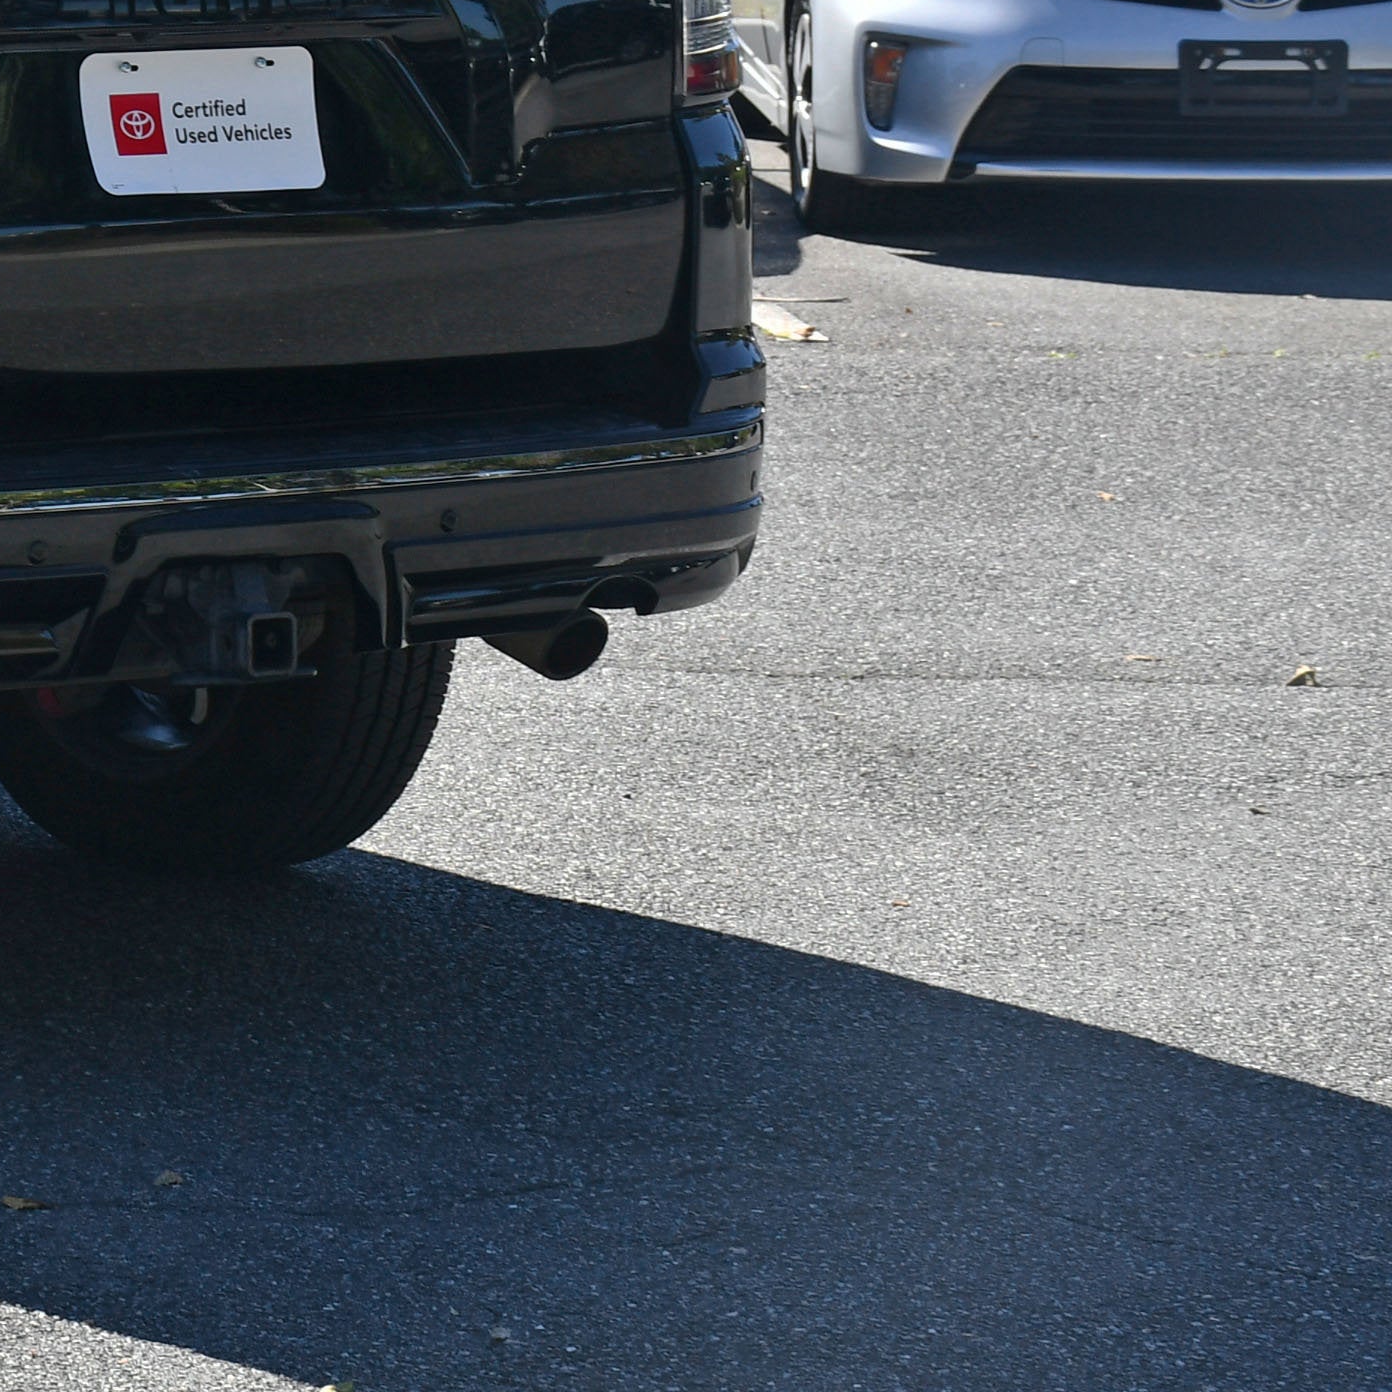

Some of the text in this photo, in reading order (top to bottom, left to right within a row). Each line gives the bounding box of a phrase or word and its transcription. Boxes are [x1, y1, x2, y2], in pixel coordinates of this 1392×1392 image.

[171, 98, 246, 119] Certified
[175, 122, 292, 144] Used Vehicles
